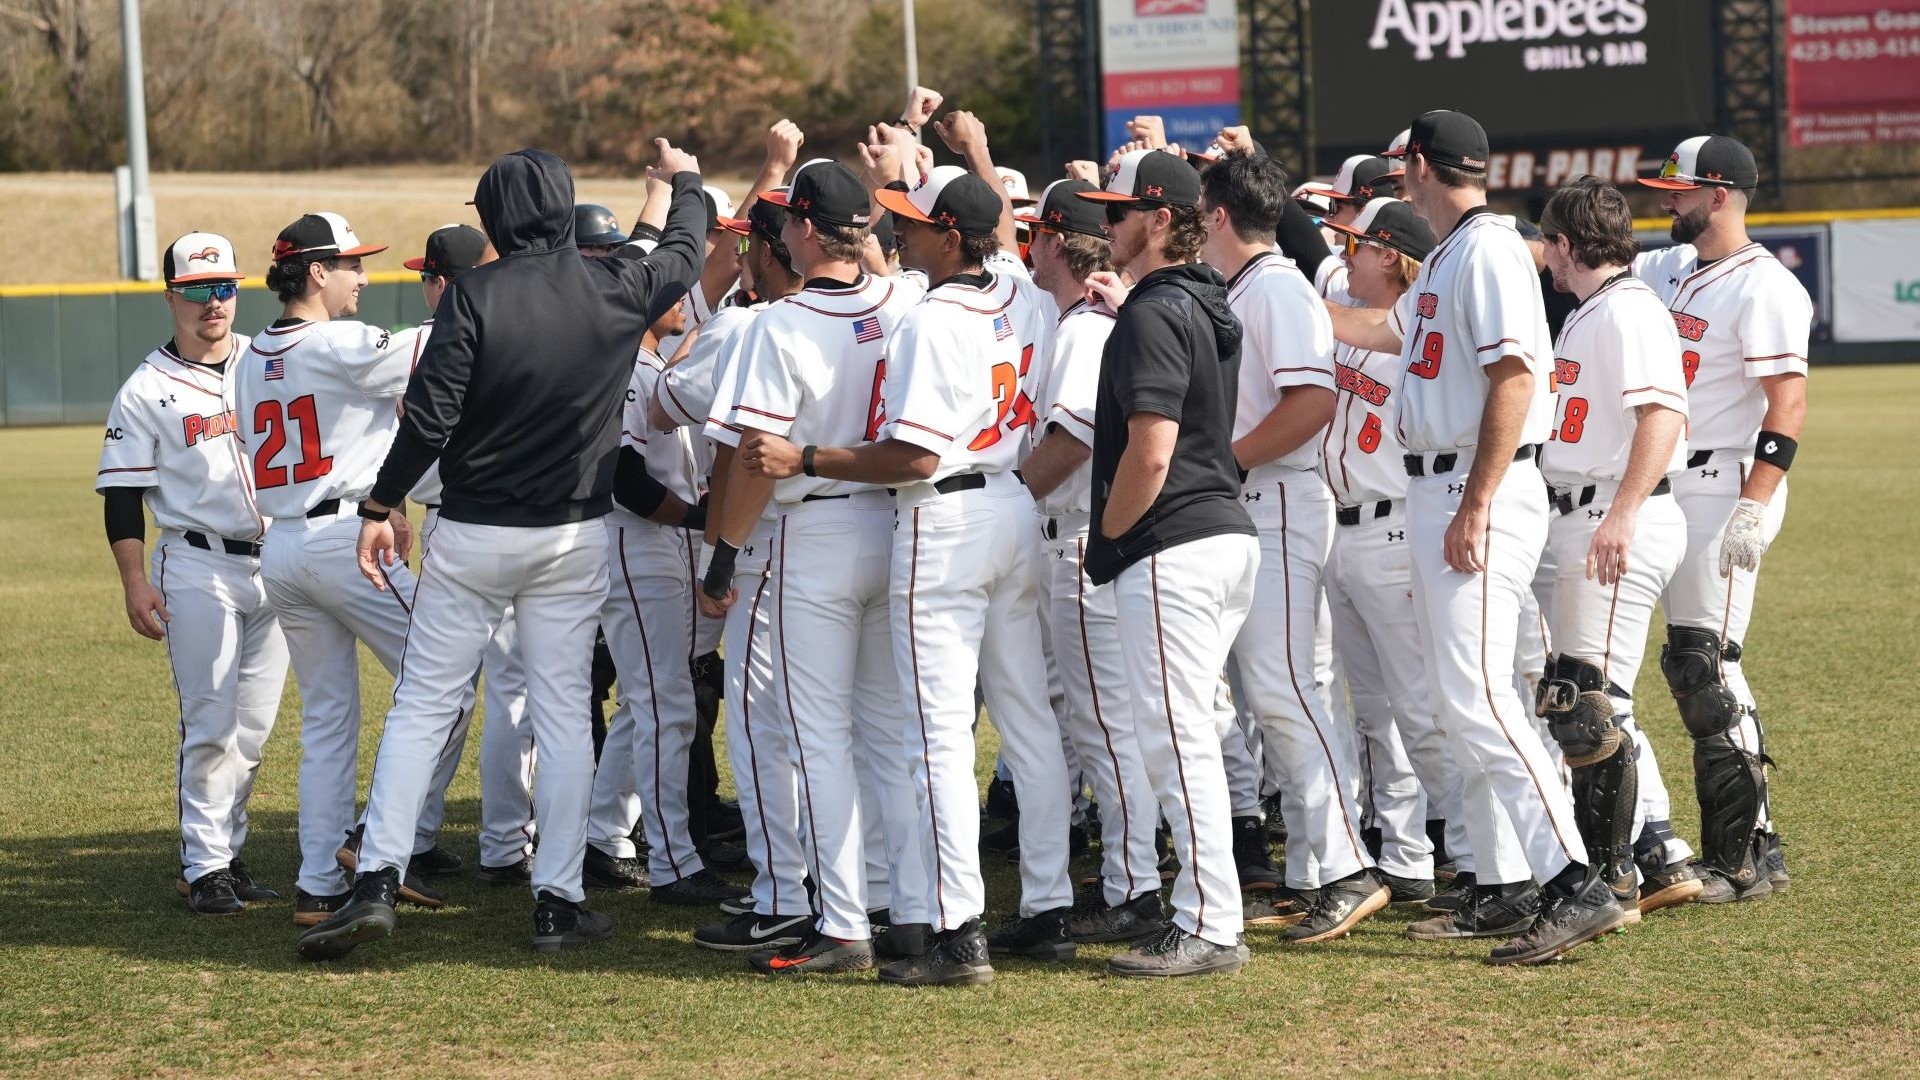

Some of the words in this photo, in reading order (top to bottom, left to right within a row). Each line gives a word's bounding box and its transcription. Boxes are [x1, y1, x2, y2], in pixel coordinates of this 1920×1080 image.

[1791, 14, 1869, 35] Steven
[1523, 45, 1586, 71] GRILL
[1602, 40, 1648, 67] BAR
[255, 393, 334, 490] 21
[1357, 411, 1383, 455] 6
